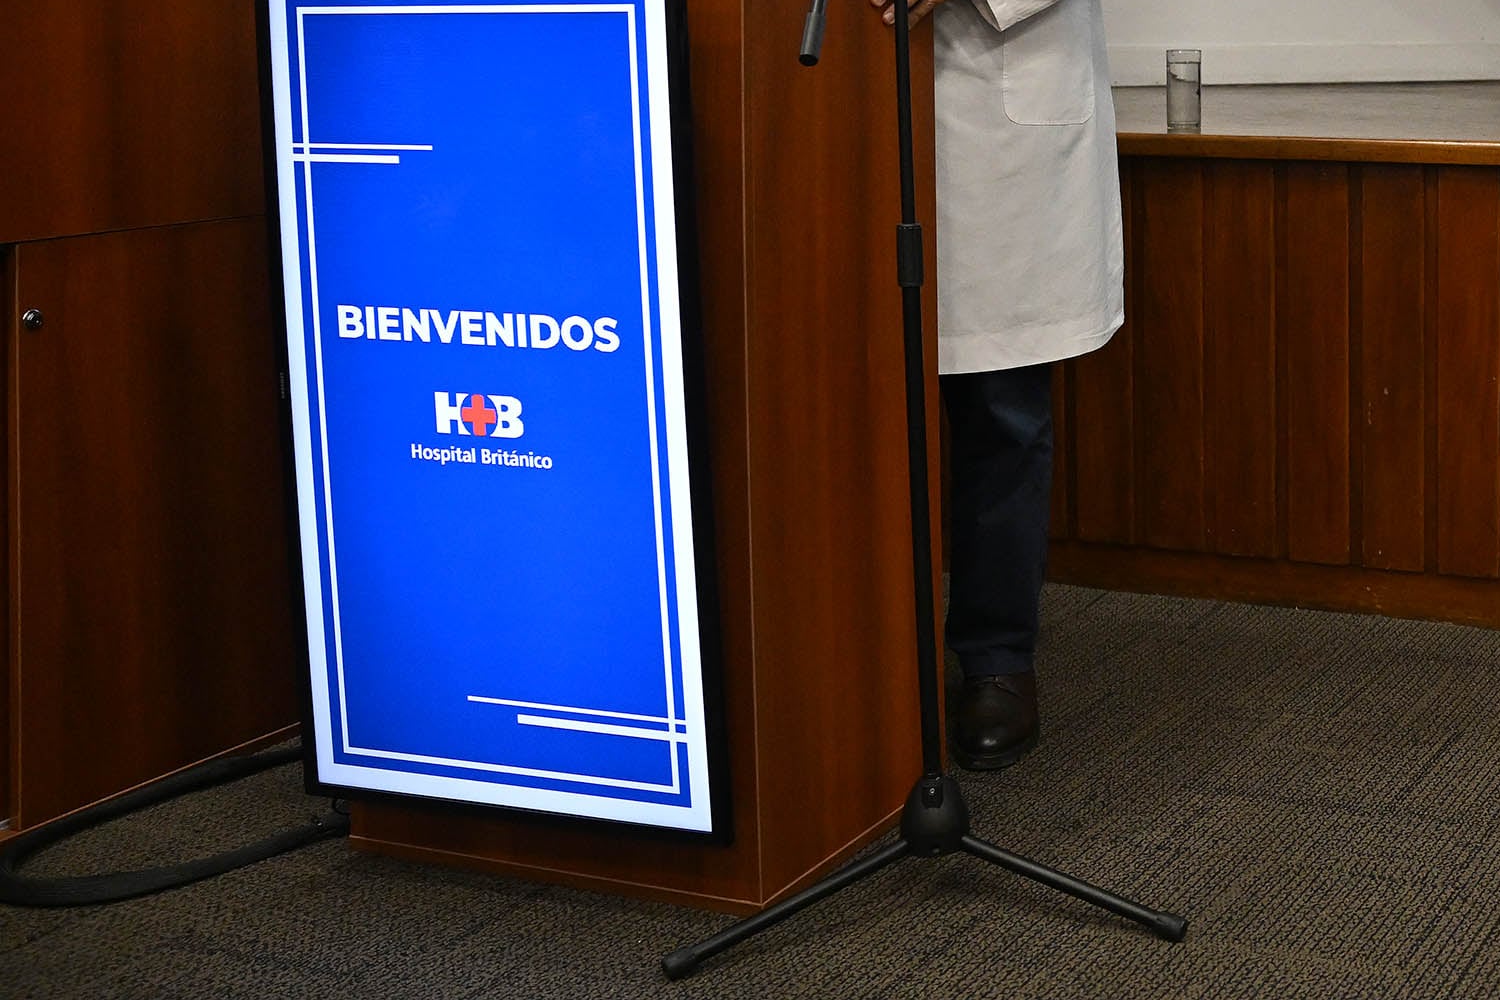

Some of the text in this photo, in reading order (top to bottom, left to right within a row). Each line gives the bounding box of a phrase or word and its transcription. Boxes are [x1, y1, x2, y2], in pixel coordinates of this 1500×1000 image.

[337, 304, 621, 353] BIENVENIDOS
[410, 443, 553, 470] Hospital Británico
